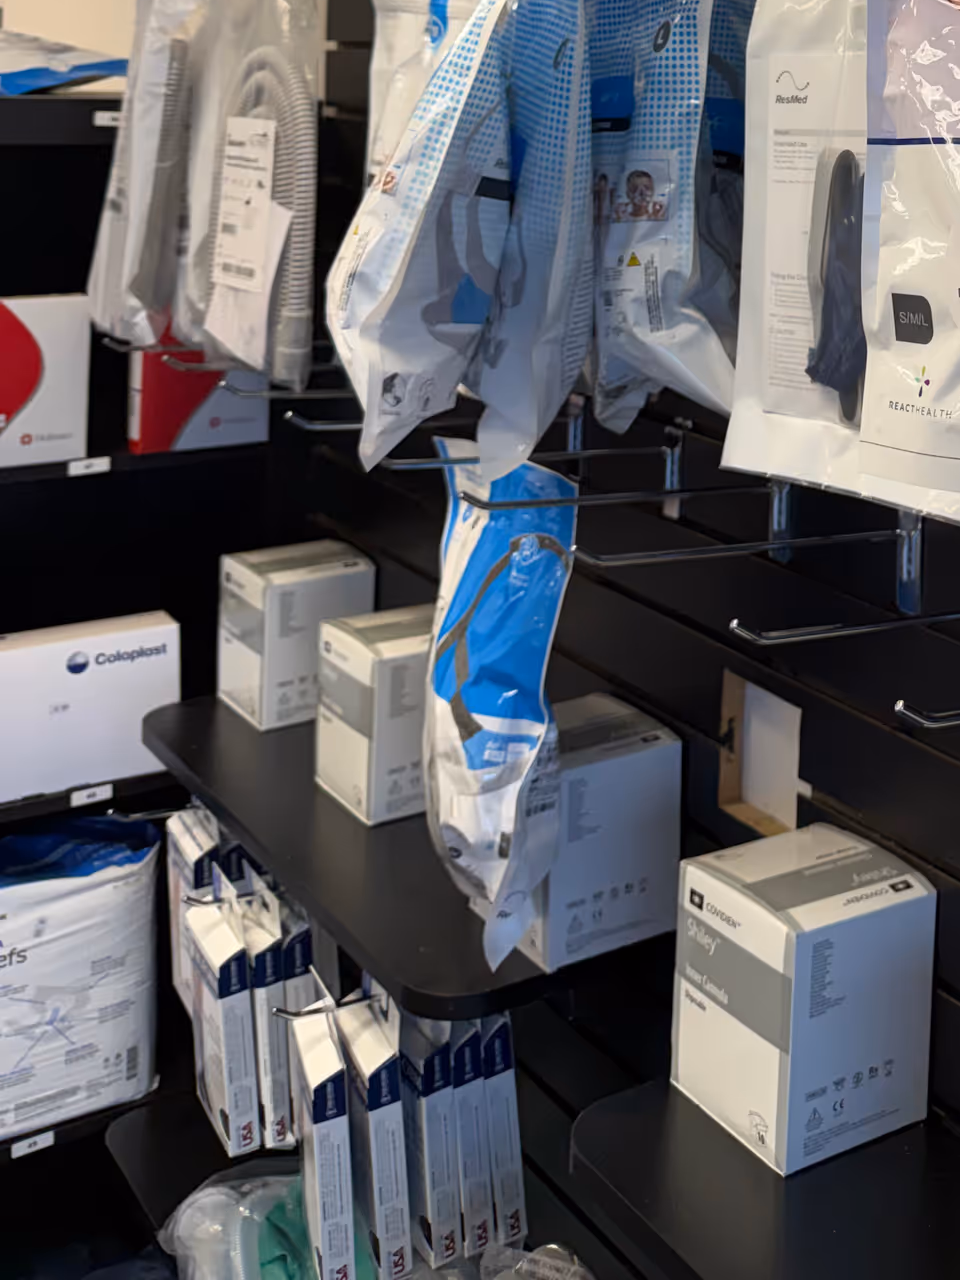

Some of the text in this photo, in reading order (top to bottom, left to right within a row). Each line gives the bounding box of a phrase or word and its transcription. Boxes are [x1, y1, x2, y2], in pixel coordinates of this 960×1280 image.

[774, 94, 809, 105] ResMed
[898, 311, 929, 328] S/M/L
[888, 400, 953, 420] REACTHEALTH
[94, 642, 168, 667] Coloplast
[240, 1121, 255, 1148] USA
[275, 1114, 287, 1142] USA
[443, 1229, 456, 1258] USA
[476, 1219, 489, 1248] USA
